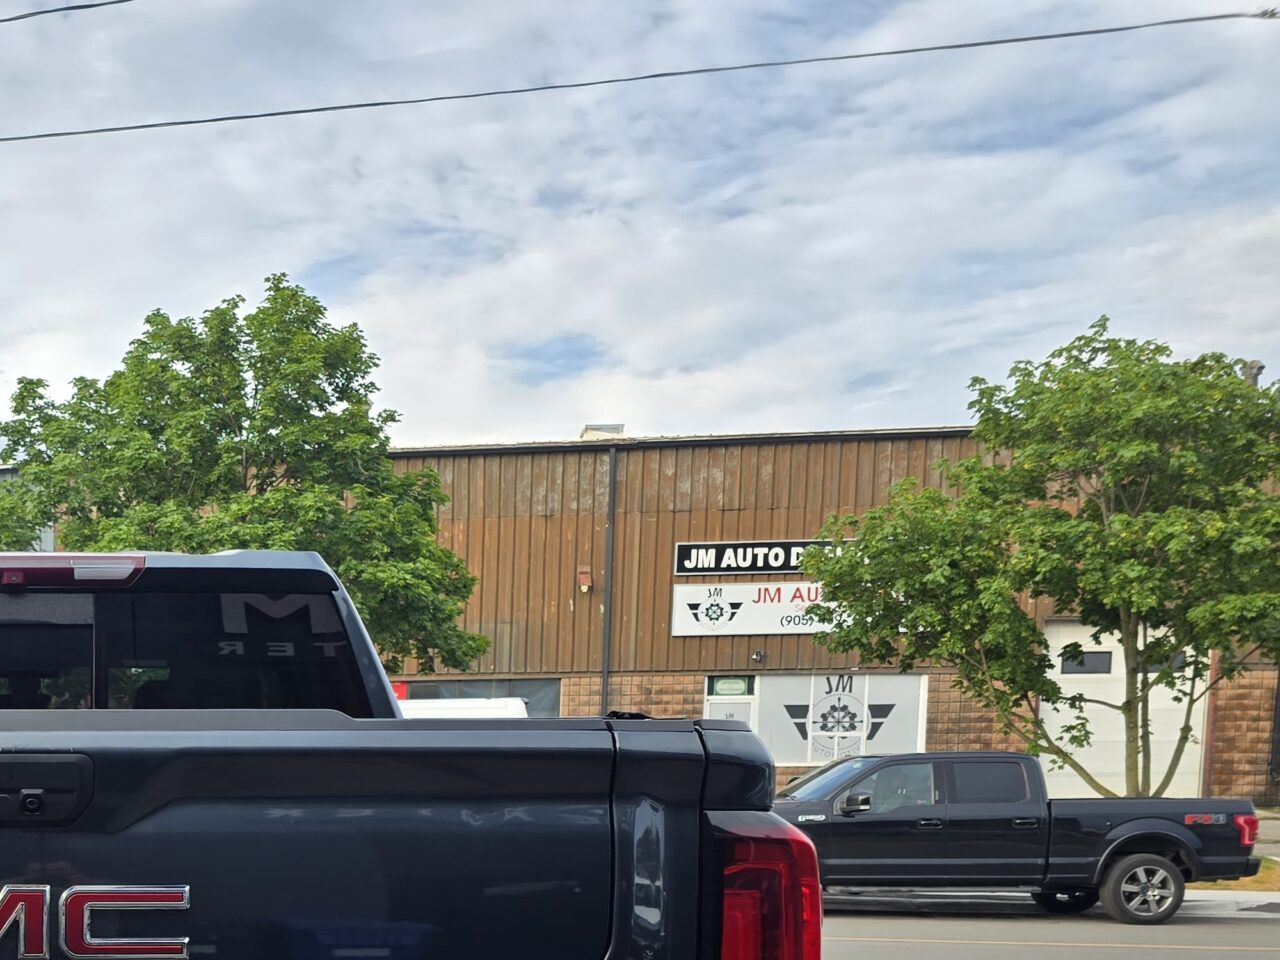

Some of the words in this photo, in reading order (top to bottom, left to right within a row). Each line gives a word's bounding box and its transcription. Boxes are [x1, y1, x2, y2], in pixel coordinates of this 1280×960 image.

[684, 548, 716, 568] JM
[720, 547, 785, 568] AUTO
[707, 587, 723, 598] JM
[752, 587, 782, 604] JM
[825, 675, 854, 694] JM
